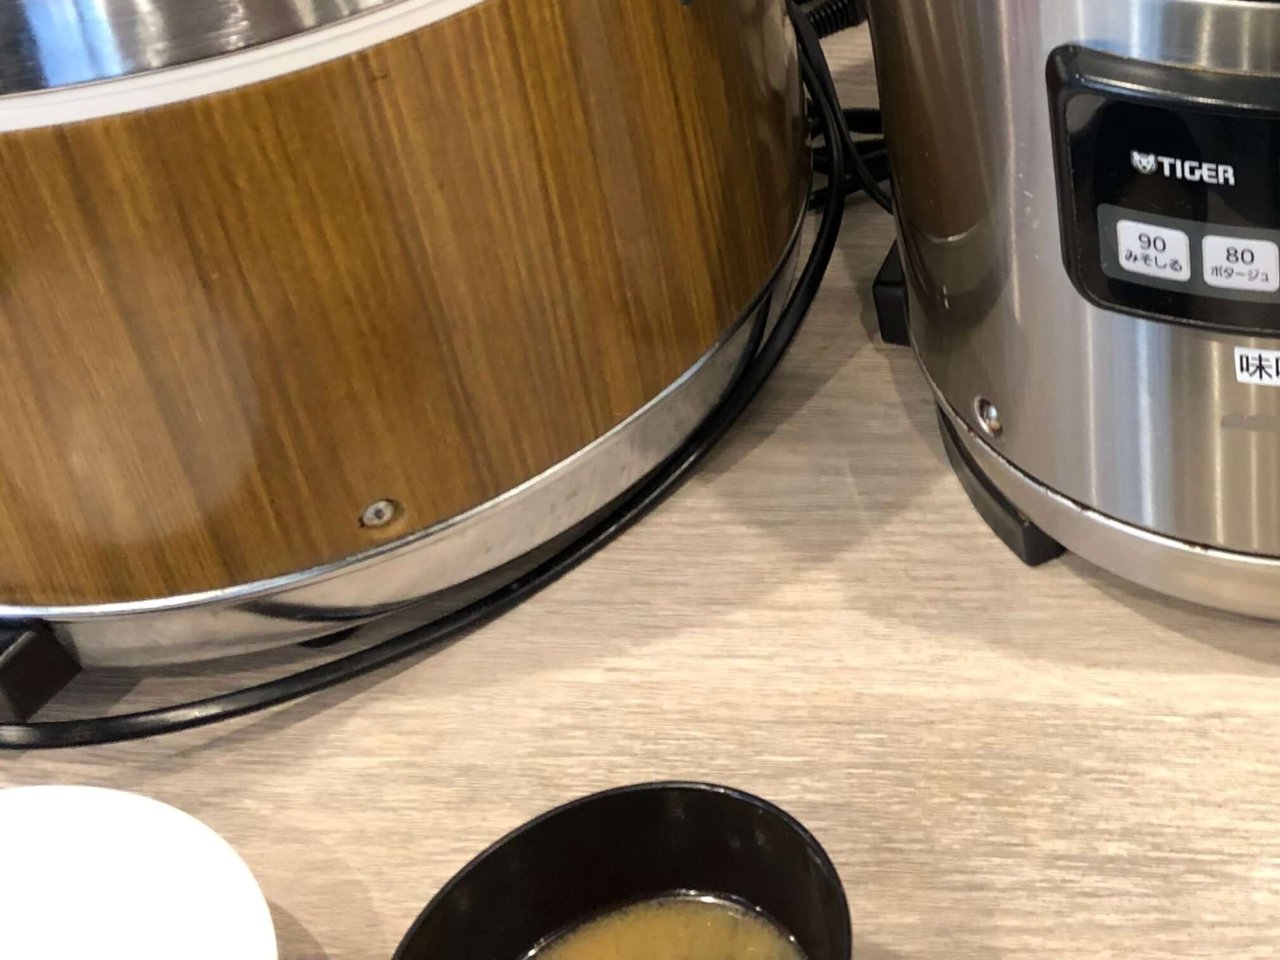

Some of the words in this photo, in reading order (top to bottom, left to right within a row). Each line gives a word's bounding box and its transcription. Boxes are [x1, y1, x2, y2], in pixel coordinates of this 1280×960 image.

[1157, 155, 1235, 186] TIGER
[1137, 232, 1167, 253] 90
[1124, 249, 1183, 272] みそしる
[1225, 246, 1255, 266] 80
[1210, 265, 1270, 283] ポタージュ
